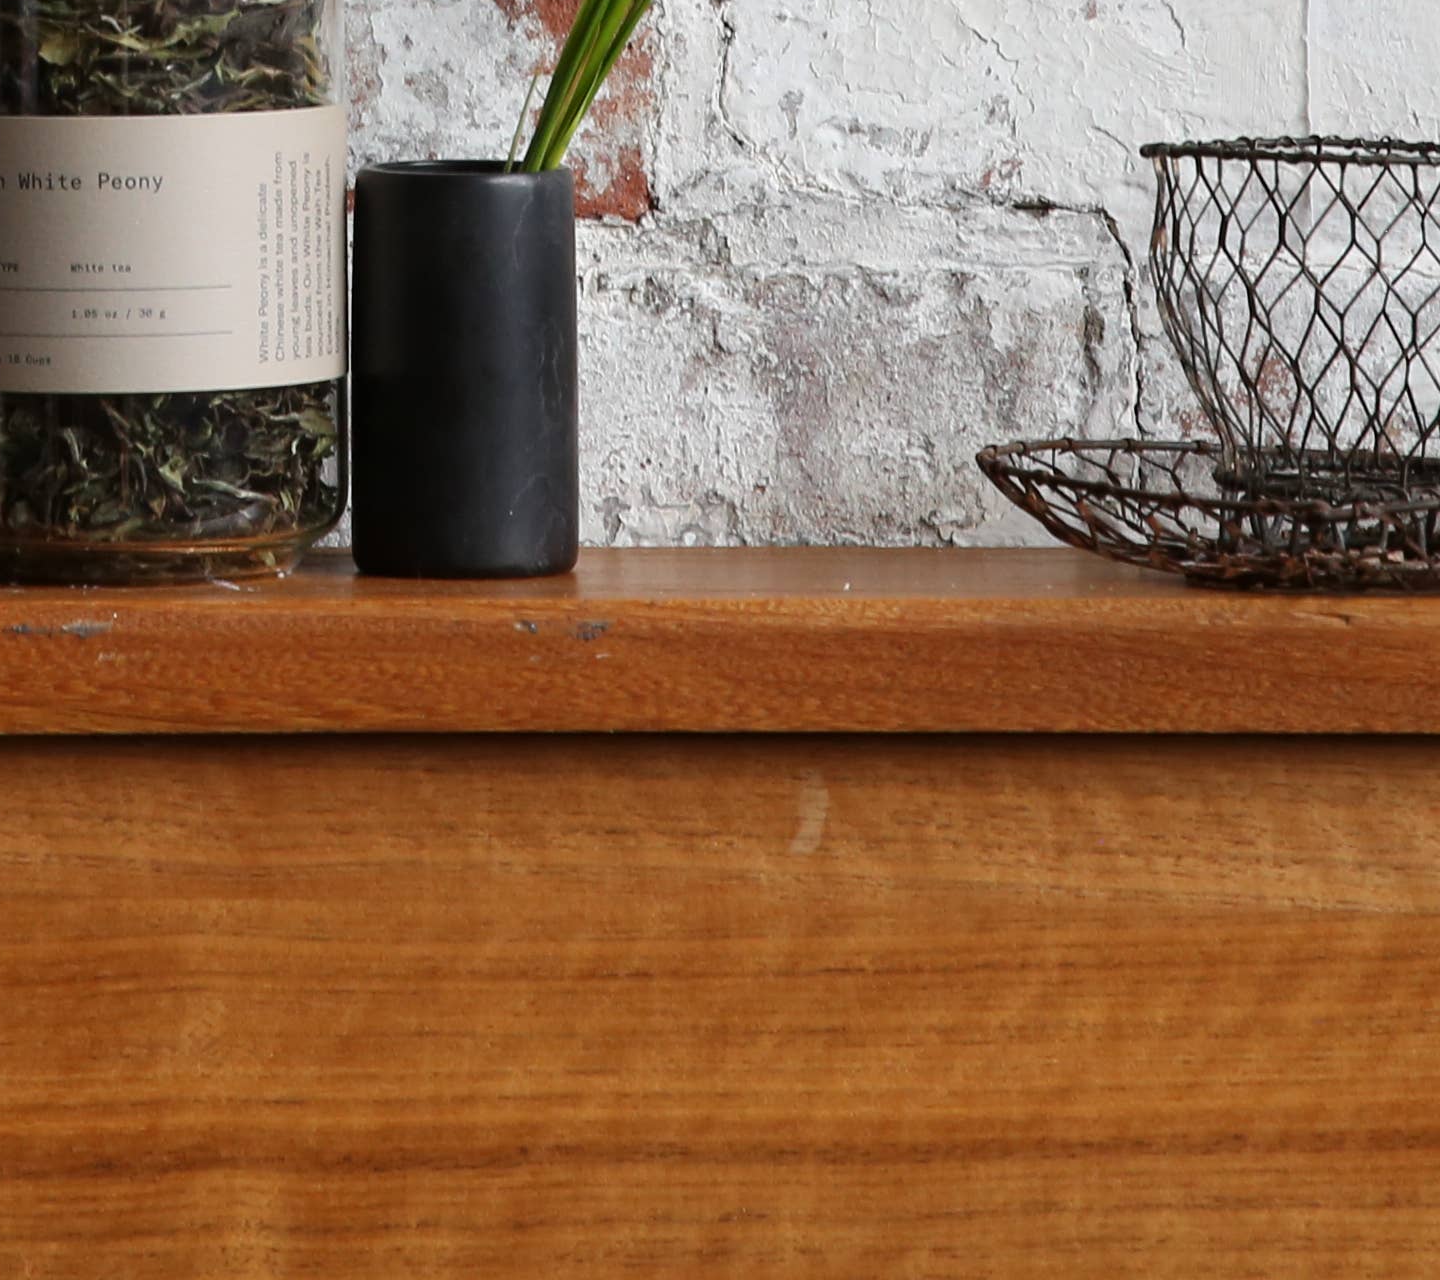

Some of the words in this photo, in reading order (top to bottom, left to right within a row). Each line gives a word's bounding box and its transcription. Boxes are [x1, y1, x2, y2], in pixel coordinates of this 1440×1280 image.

[274, 152, 283, 184] from
[302, 152, 311, 164] is
[19, 172, 82, 190] White
[98, 172, 163, 193] Peony
[289, 160, 300, 232] unopened
[303, 168, 312, 211] Peony
[258, 183, 268, 240] delicate
[274, 189, 284, 228] made
[260, 245, 268, 253] a
[276, 234, 284, 256] tea
[290, 238, 299, 264] and
[303, 216, 311, 258] White
[71, 263, 104, 272] White
[112, 264, 131, 272] tea
[259, 258, 269, 269] is
[275, 260, 284, 298] white
[304, 263, 312, 288] Our
[259, 274, 271, 317] Peony
[290, 268, 299, 312] leaves
[260, 322, 269, 363] White
[276, 303, 285, 361] Chinese
[291, 317, 302, 360] young
[305, 337, 313, 359] tea
